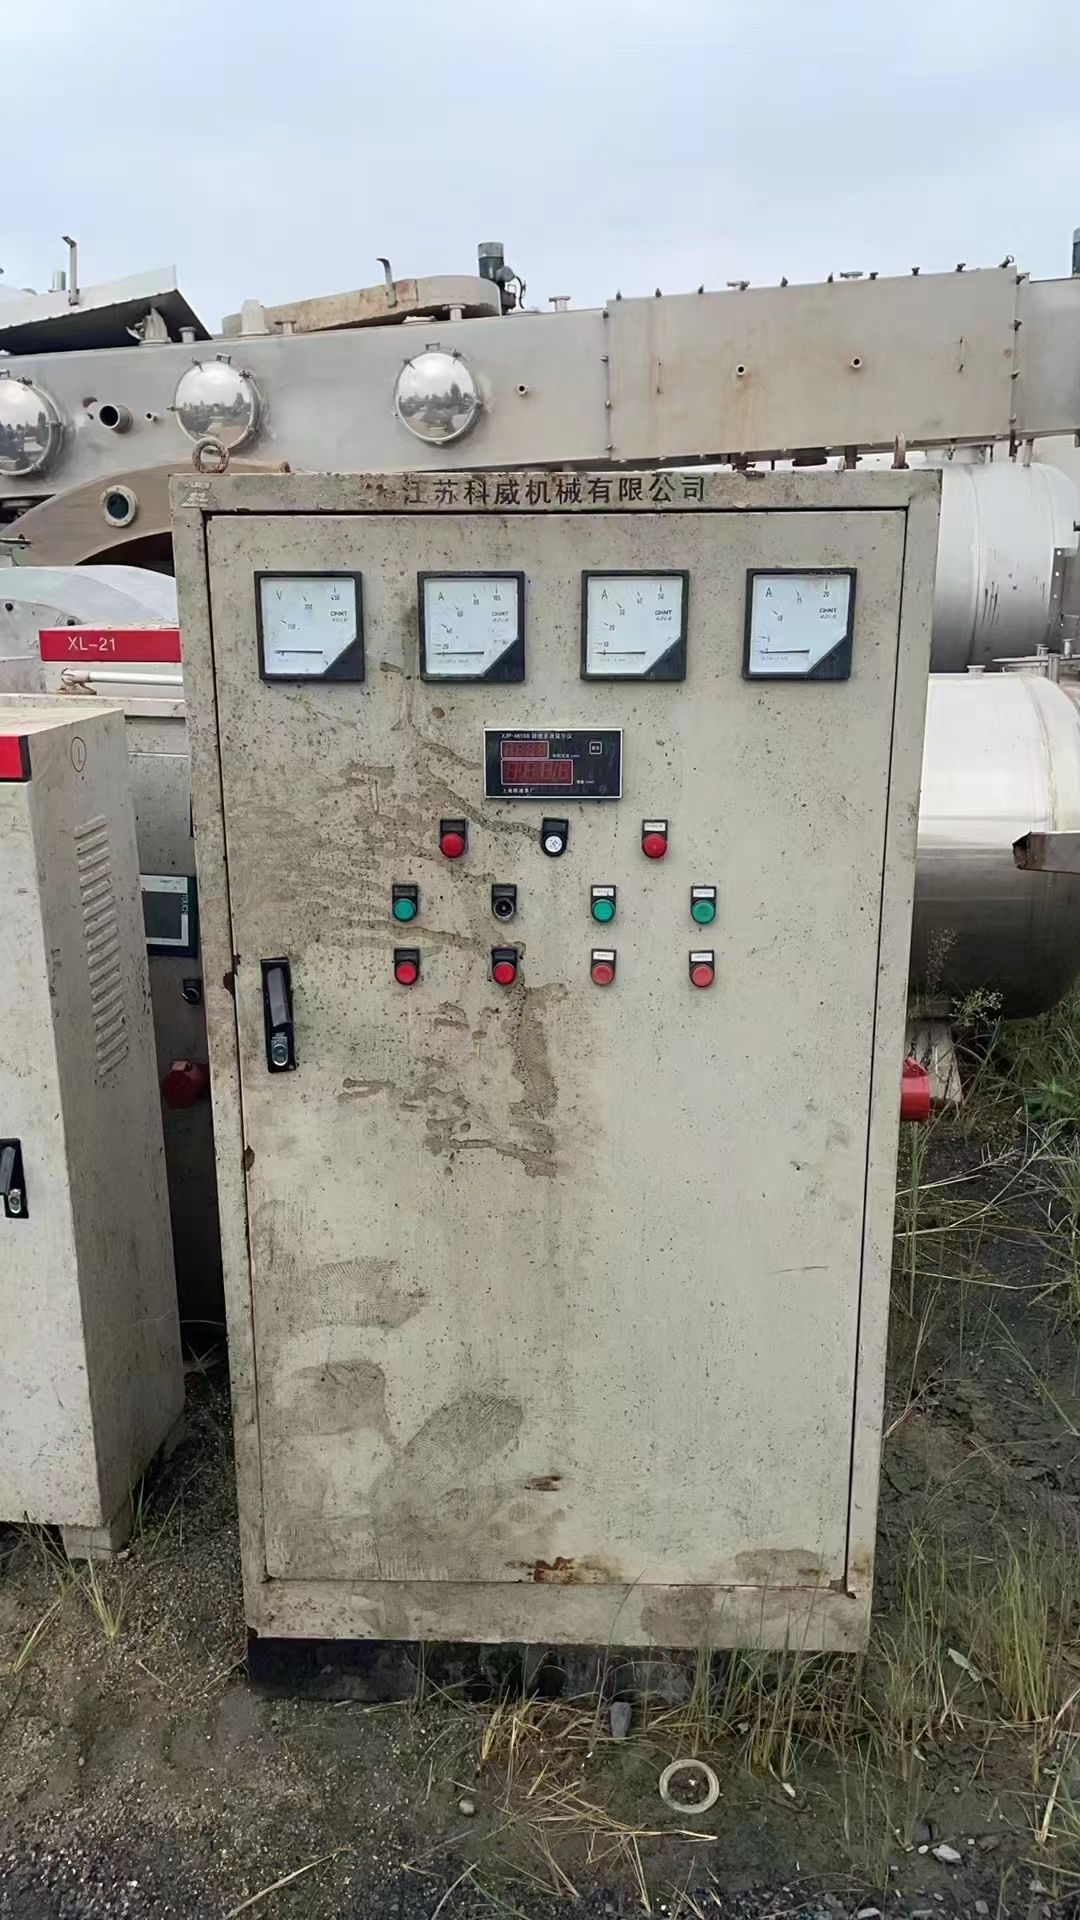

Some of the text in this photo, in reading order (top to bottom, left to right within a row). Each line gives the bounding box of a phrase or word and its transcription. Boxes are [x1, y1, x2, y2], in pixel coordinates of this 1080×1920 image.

[403, 477, 704, 505] 江苏科威机械有限公司
[438, 592, 445, 601] A
[601, 589, 608, 600] A
[765, 587, 773, 598] A
[67, 635, 117, 652] XL-21
